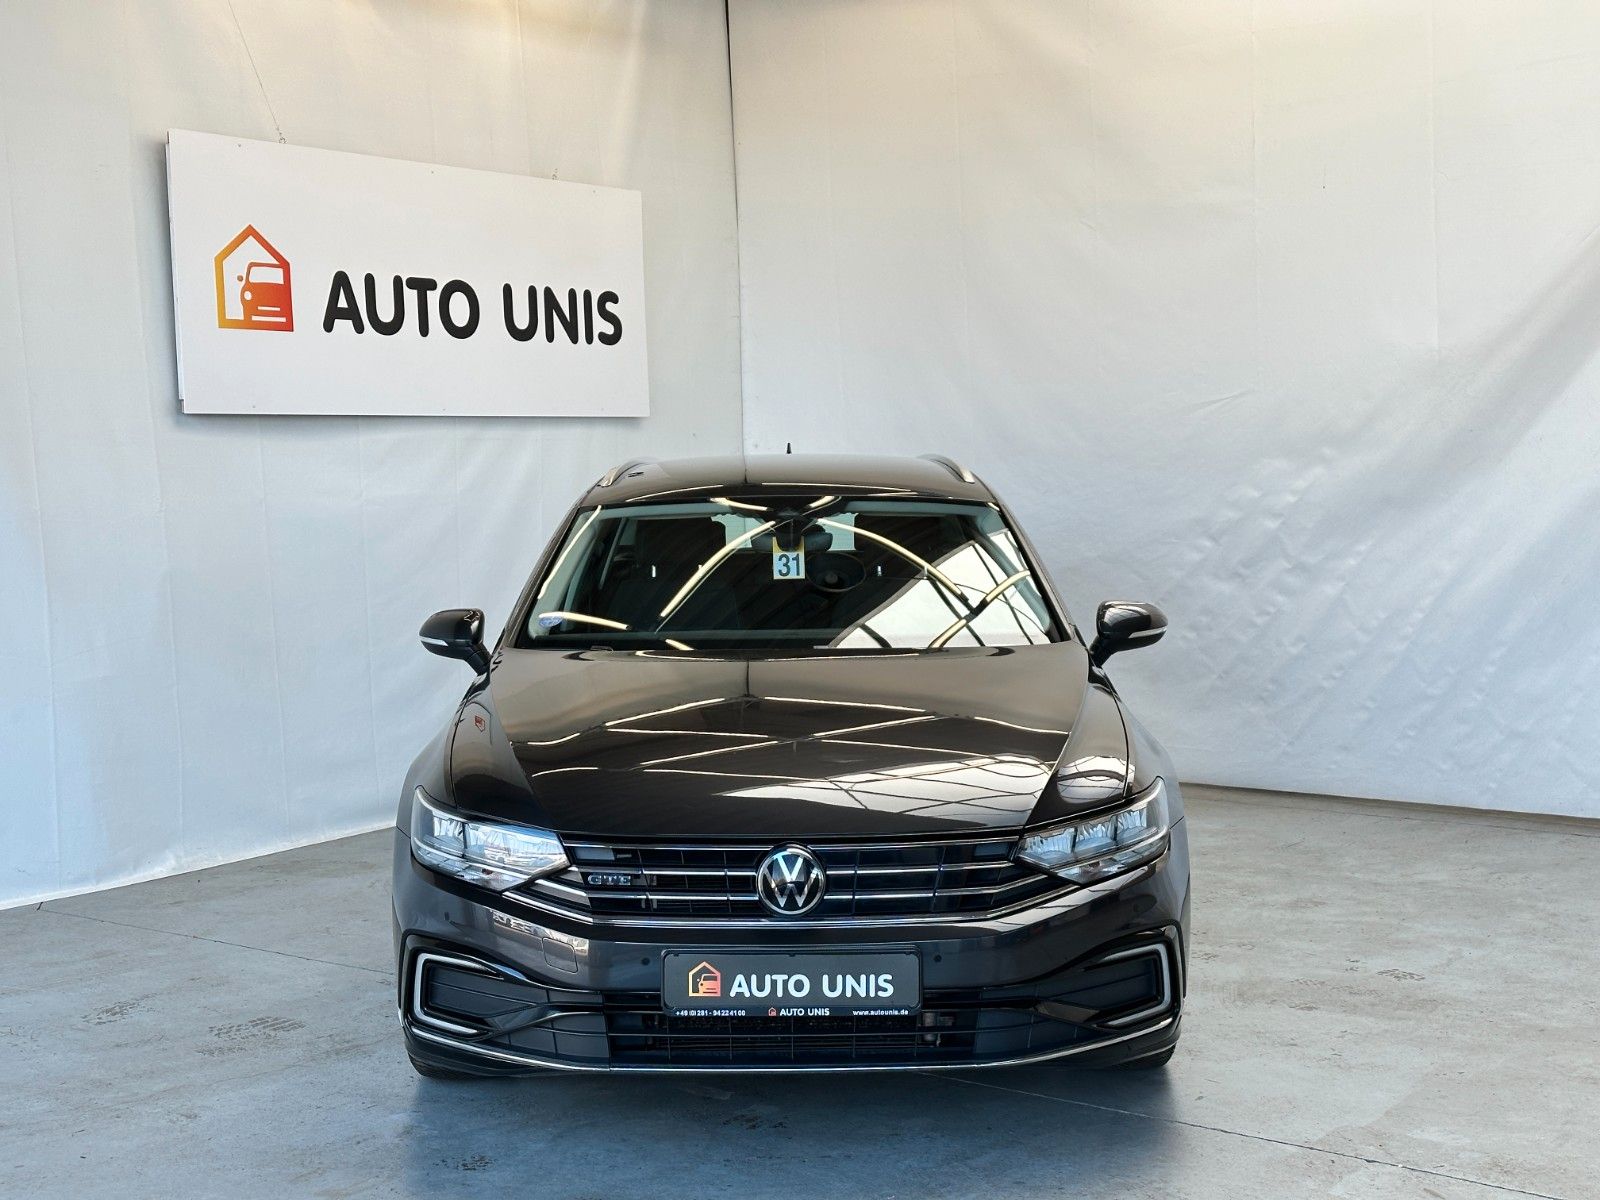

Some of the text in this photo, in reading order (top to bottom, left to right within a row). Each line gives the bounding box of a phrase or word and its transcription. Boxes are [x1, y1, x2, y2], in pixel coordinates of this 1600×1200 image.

[323, 270, 623, 346] AUTO UNIS
[778, 553, 800, 577] 31
[587, 874, 631, 886] GTE
[729, 974, 894, 998] AUTO UNIS
[779, 1008, 830, 1016] AUTO UNIS
